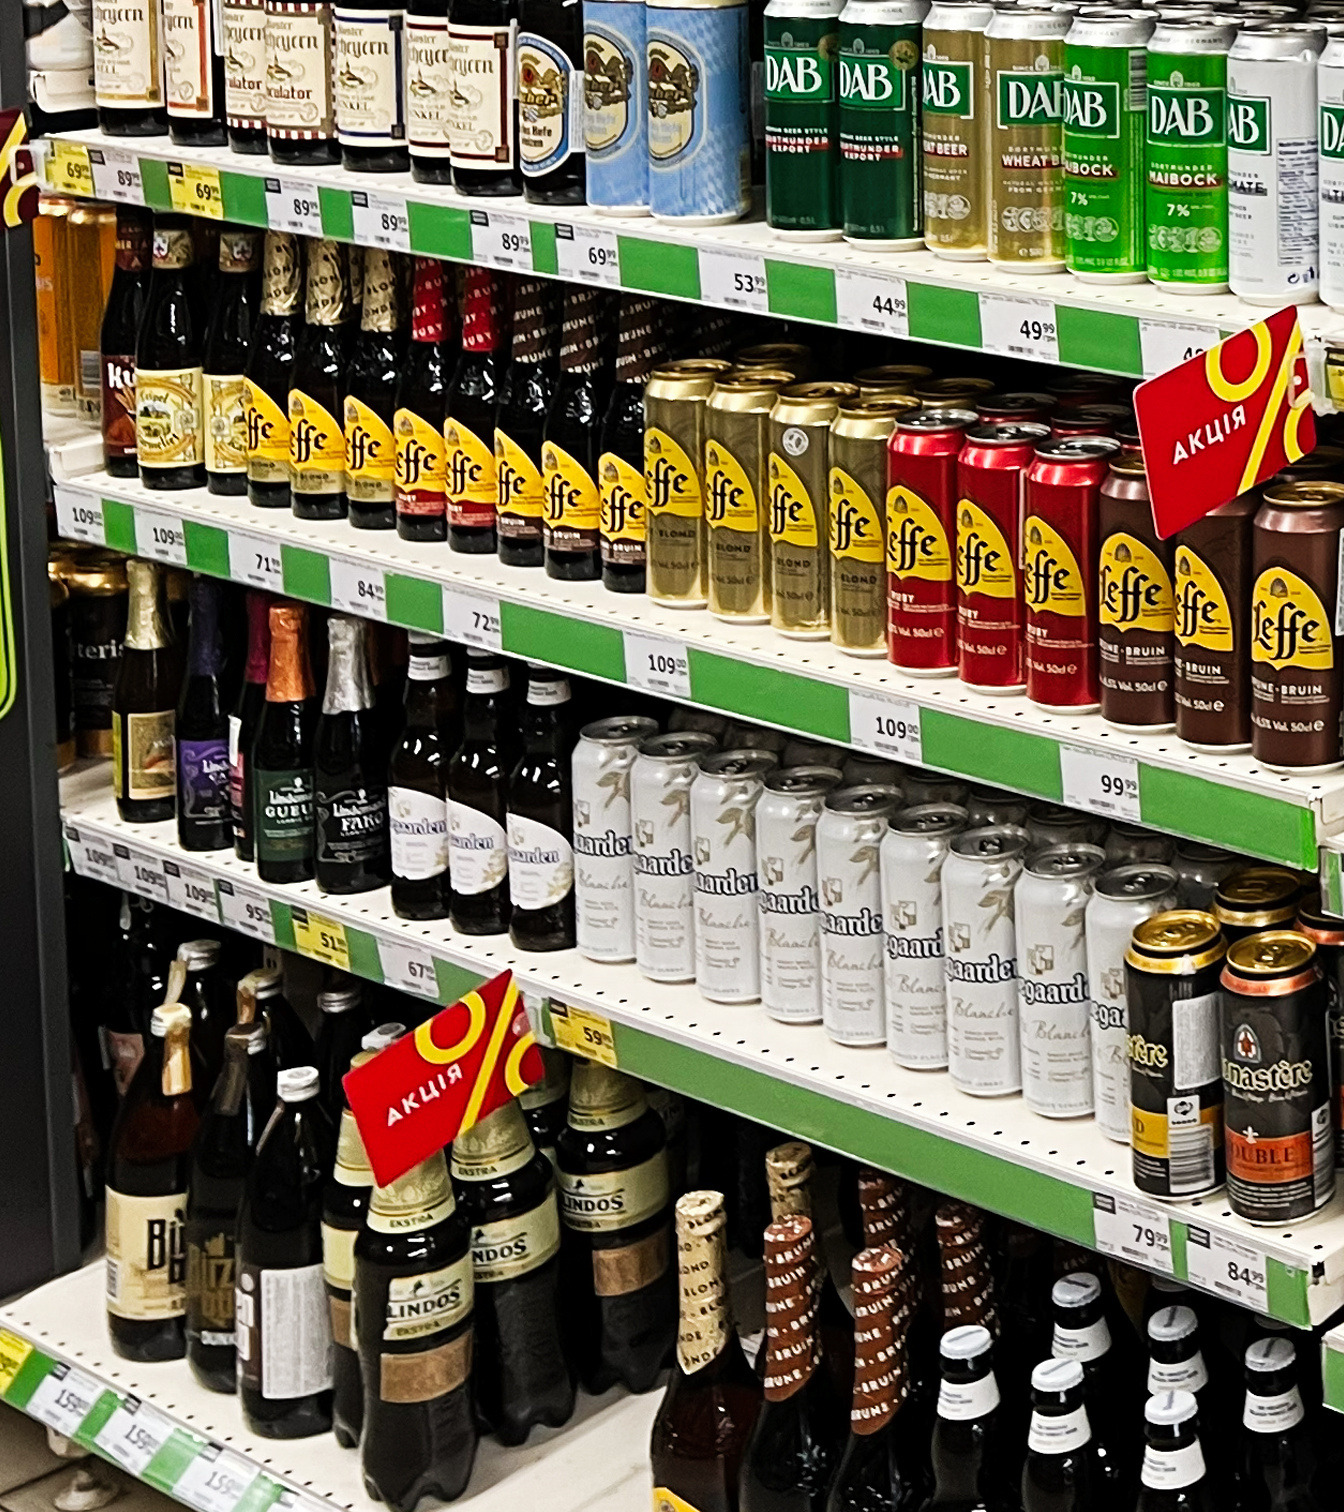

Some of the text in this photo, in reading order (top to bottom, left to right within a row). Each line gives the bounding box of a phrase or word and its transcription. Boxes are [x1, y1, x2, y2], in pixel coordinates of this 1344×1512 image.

[765, 56, 823, 95] DAB
[839, 67, 893, 101] DAB
[1150, 100, 1214, 136] DAB
[1002, 154, 1049, 168] WHEAT
[1149, 169, 1218, 187] MAIBOCK
[733, 273, 754, 292] 53
[872, 294, 894, 314] 44
[1019, 320, 1041, 340] 49
[1172, 405, 1248, 466] АКЦІЯ
[875, 717, 906, 739] 109
[1100, 776, 1124, 796] 99
[387, 1063, 465, 1127] АКЦІЯ
[562, 1192, 624, 1214] LINDOS
[389, 1213, 435, 1229] EKSTRA
[1131, 1226, 1155, 1247] 79
[1227, 1262, 1251, 1282] 84
[388, 1285, 461, 1320] LINDOS
